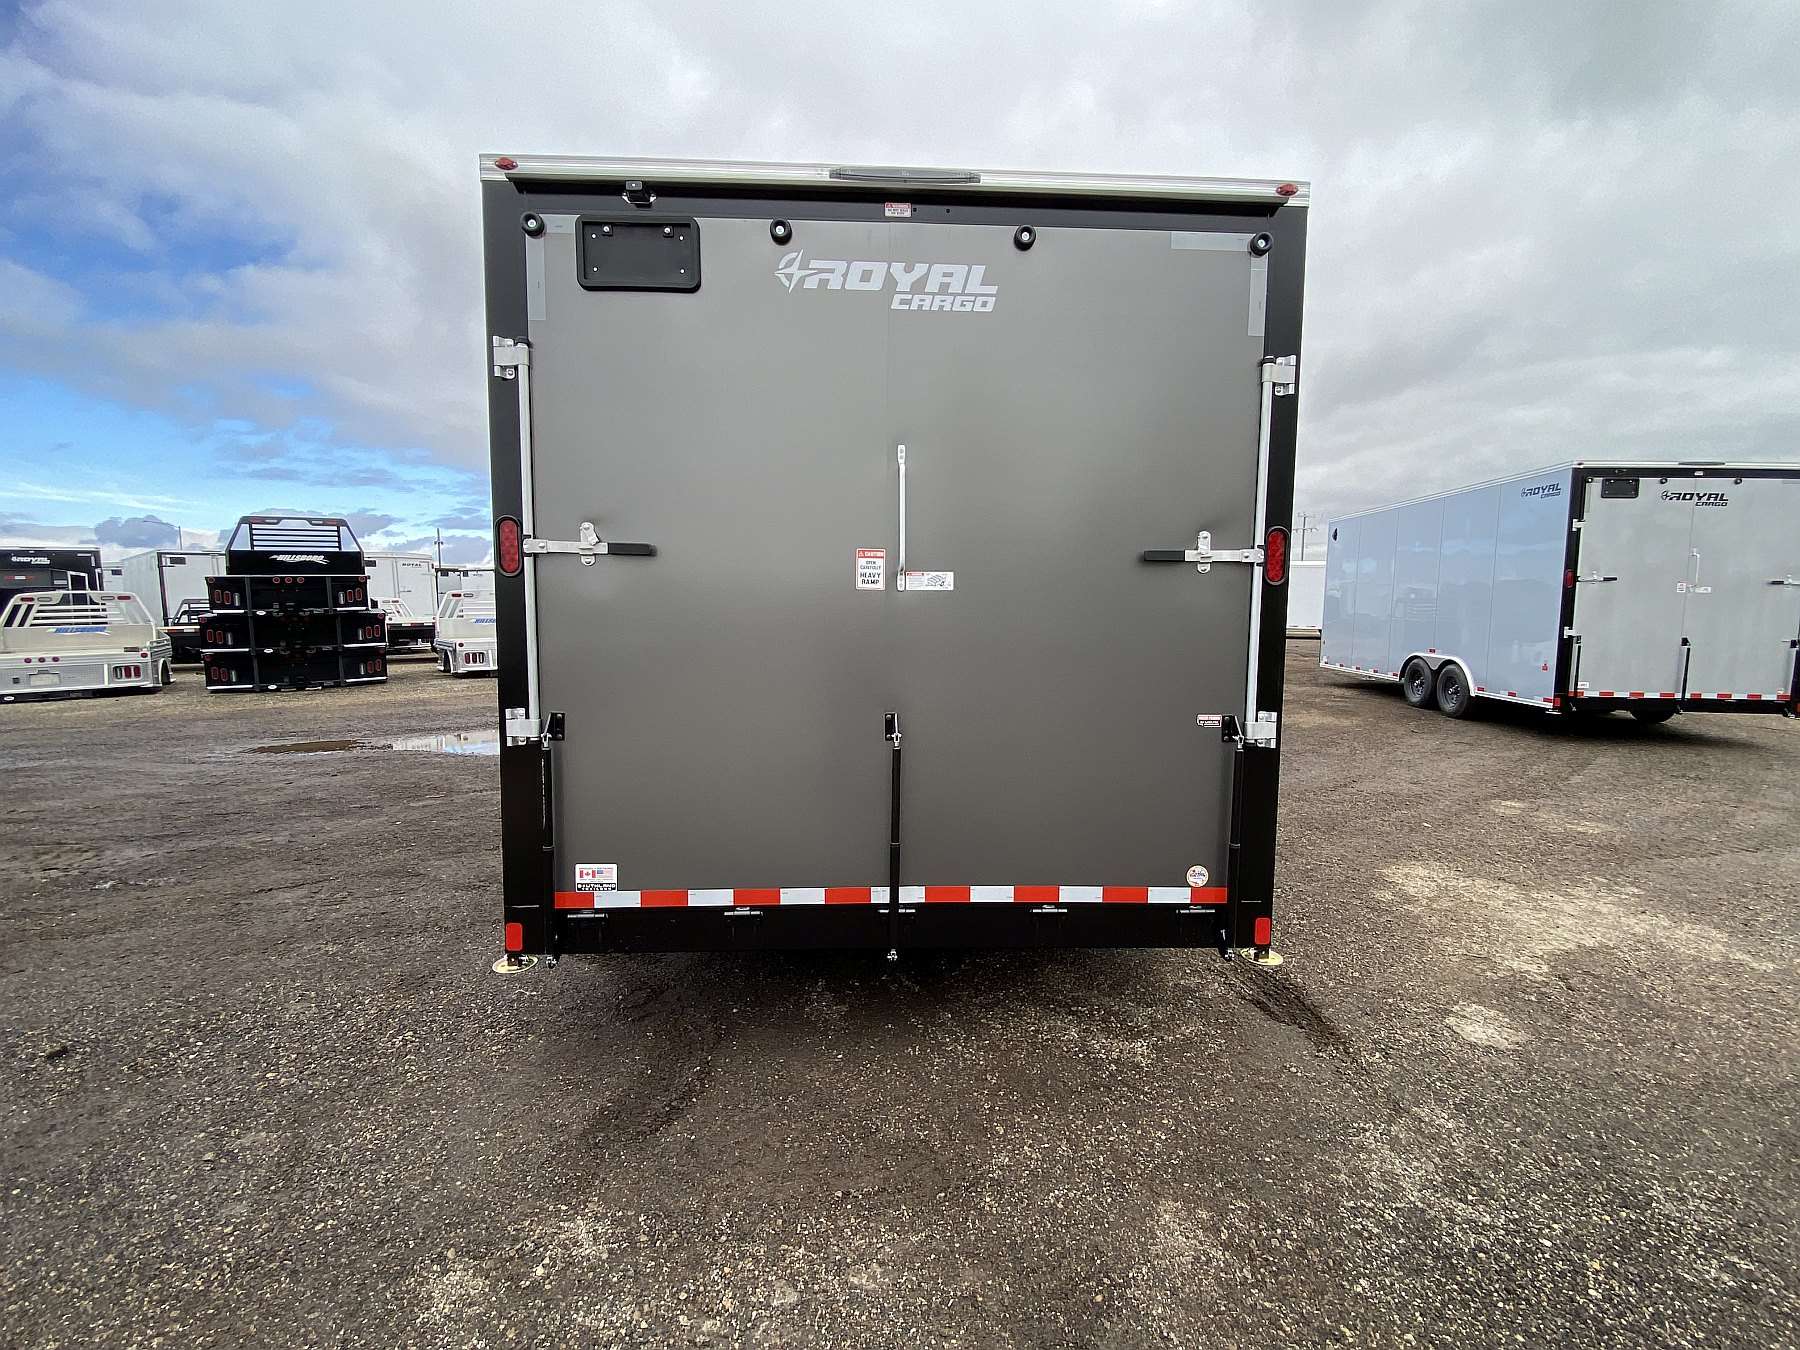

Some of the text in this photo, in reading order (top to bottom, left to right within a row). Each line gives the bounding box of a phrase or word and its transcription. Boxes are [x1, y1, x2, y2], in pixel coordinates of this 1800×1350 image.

[803, 259, 999, 295] ROYAL
[890, 294, 997, 313] CARGO
[1527, 482, 1562, 497] ROYAL
[1669, 492, 1729, 502] ROYAL
